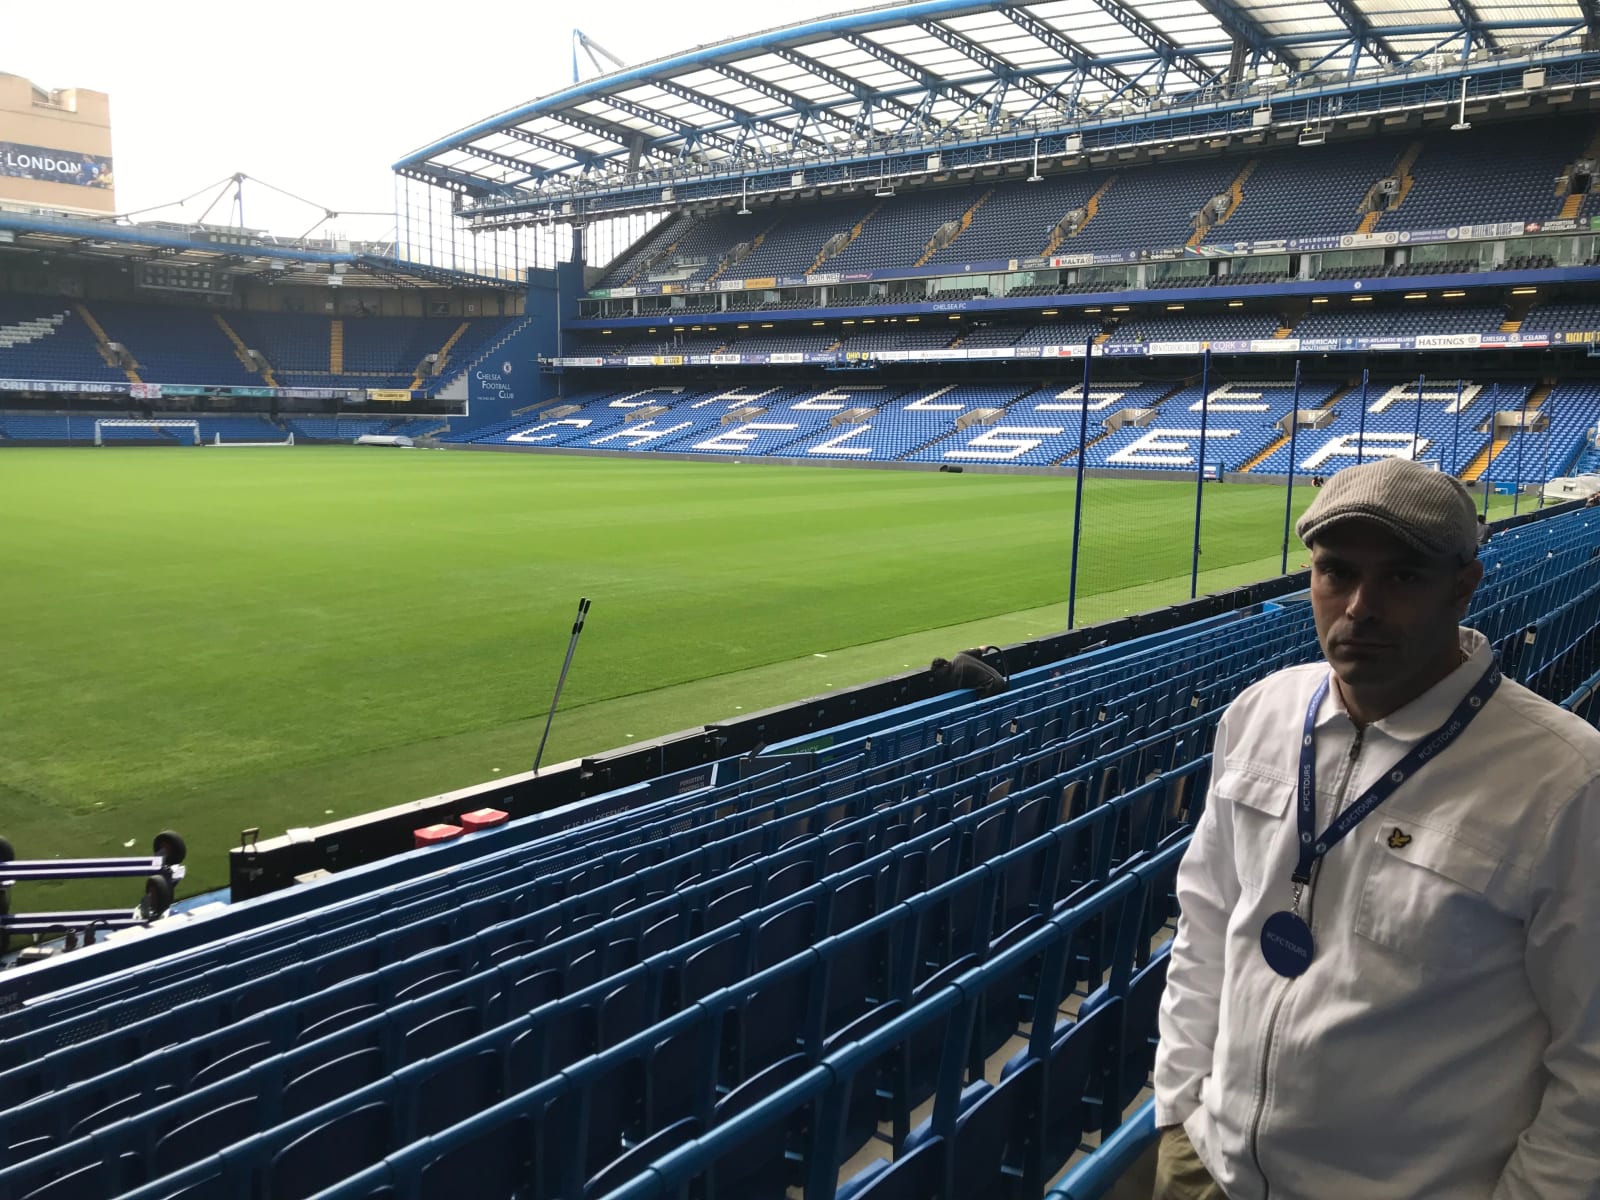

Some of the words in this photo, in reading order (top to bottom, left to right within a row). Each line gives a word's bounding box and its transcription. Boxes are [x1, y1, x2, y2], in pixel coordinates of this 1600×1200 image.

[8, 153, 81, 173] LONDON
[1061, 257, 1086, 265] MALTA
[1212, 341, 1236, 350] CORK
[1419, 337, 1465, 346] HASTINGS
[476, 371, 502, 380] CHELSEA
[33, 382, 46, 392] IS
[51, 382, 77, 392] THE
[80, 383, 111, 393] KING
[482, 380, 511, 390] FOOTBALL
[498, 390, 514, 399] CLUB
[608, 381, 1483, 414] CHELSEA
[505, 418, 1436, 470] CHELSEA
[1303, 763, 1311, 812] #CFCTOURS
